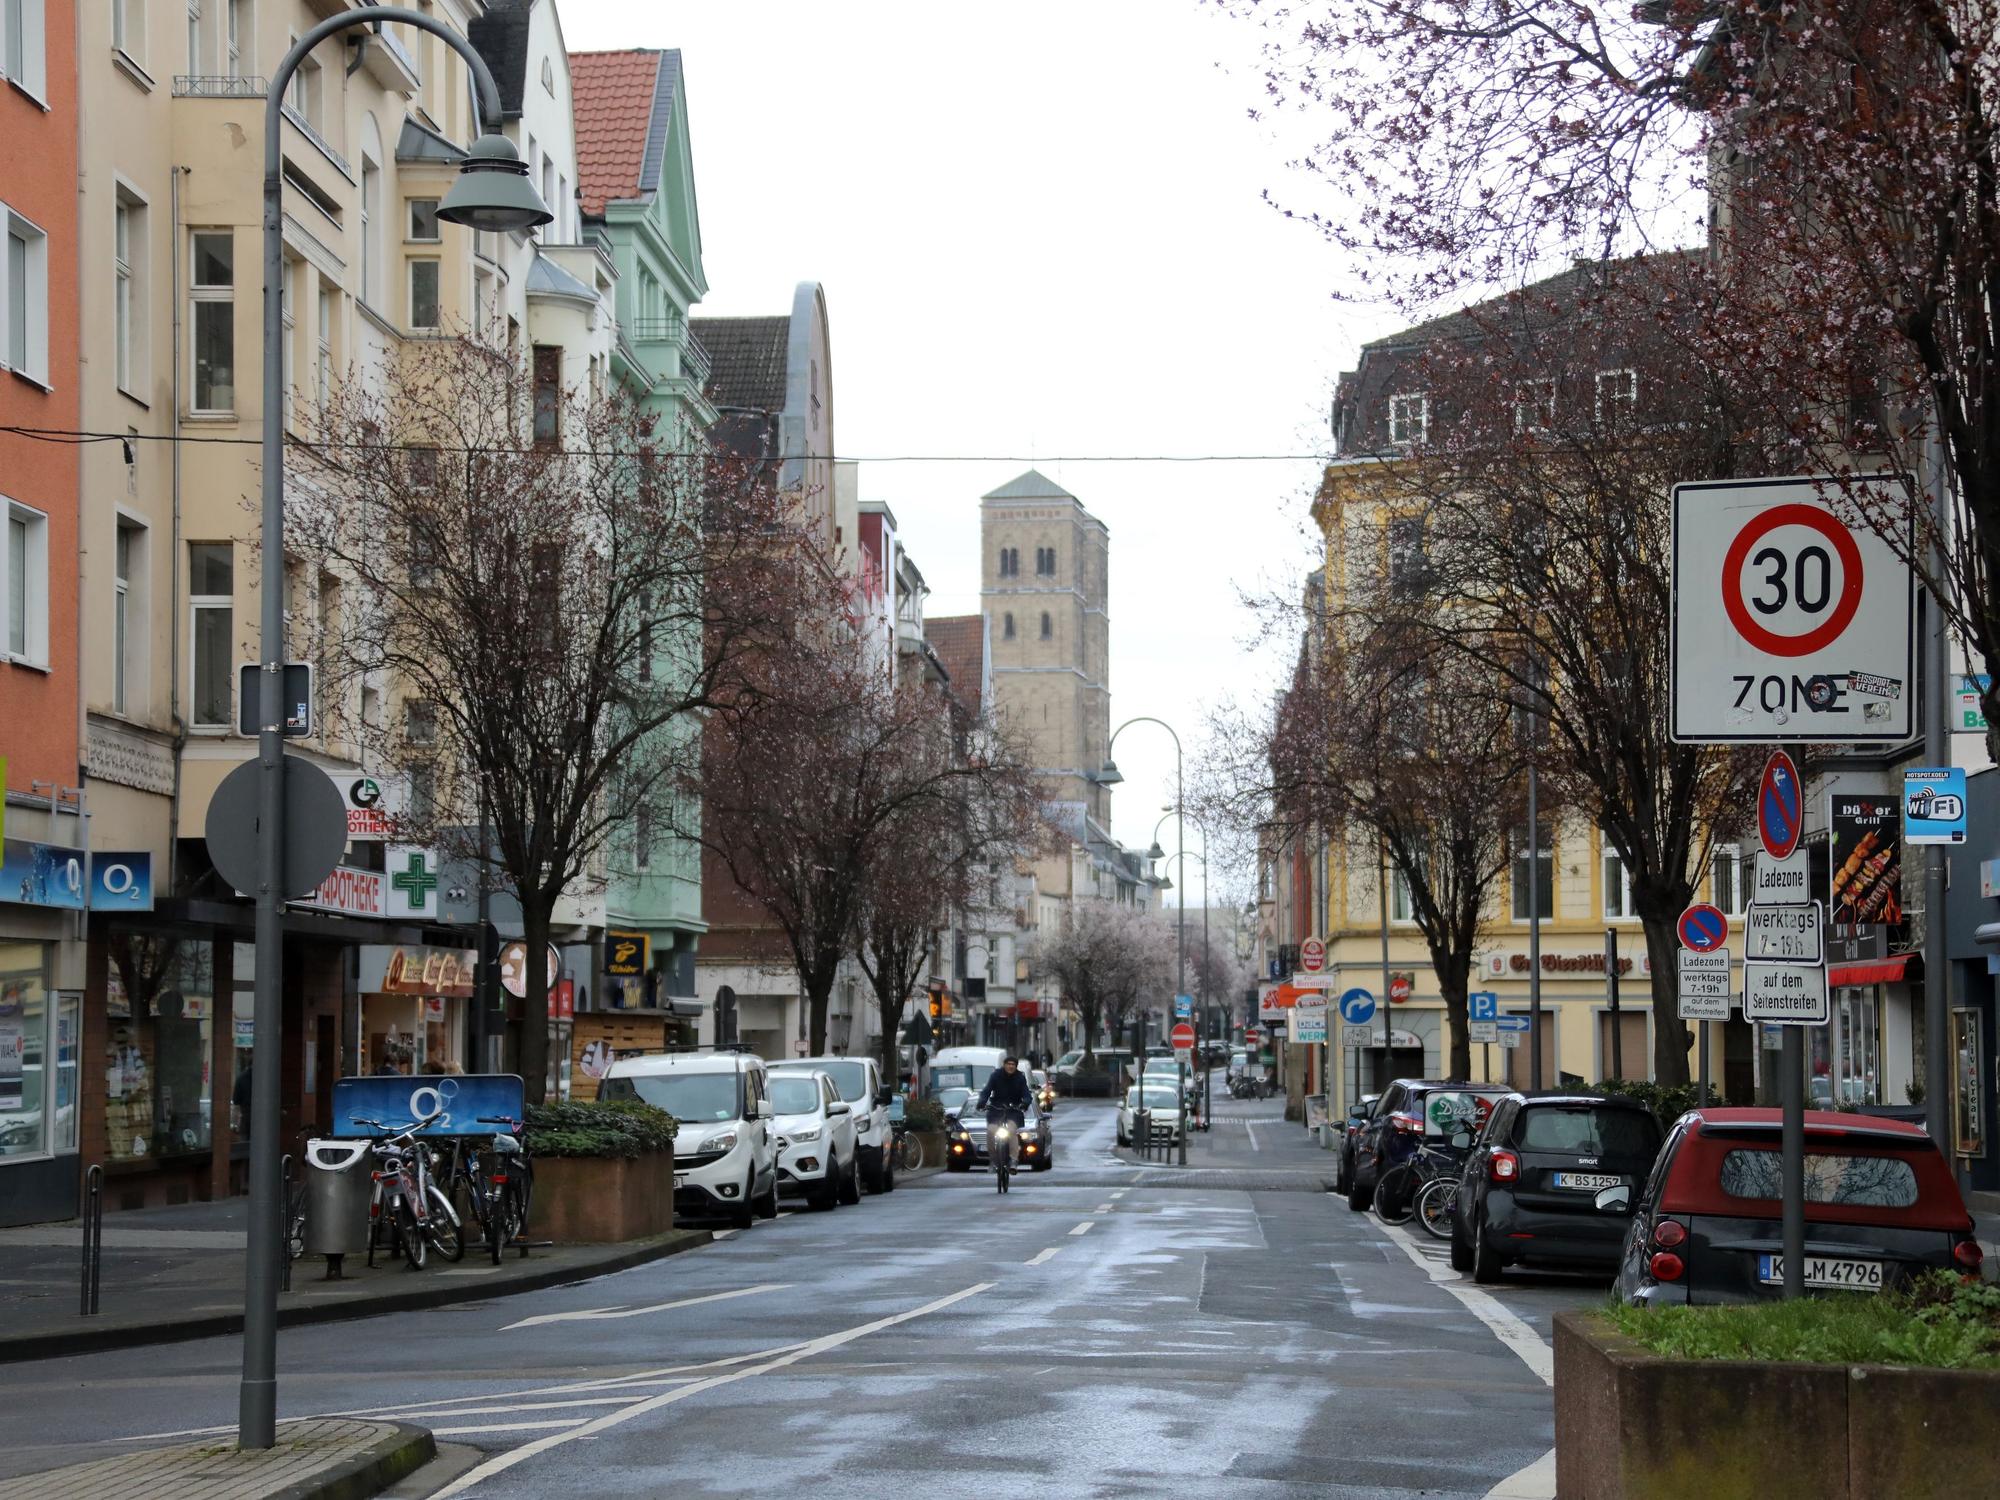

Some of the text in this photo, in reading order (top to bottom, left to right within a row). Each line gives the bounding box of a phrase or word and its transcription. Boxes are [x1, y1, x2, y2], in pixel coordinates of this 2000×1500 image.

[1752, 546, 1831, 615] 30
[1857, 673, 1890, 688] EISSPORT
[1732, 674, 1850, 714] ZONE
[1856, 682, 1889, 697] VEREIN
[1855, 816, 1880, 825] Grill
[1759, 867, 1804, 889] Ladezone
[1752, 908, 1815, 934] werktags
[1683, 956, 1725, 967] Ladezone
[1683, 973, 1728, 985] werktags
[1763, 971, 1803, 988] auf dem
[1704, 997, 1720, 1006] dem
[1752, 992, 1818, 1011] Seitenstreifen
[1437, 1100, 1488, 1116] Diana
[1560, 1174, 1568, 1186] K
[1575, 1175, 1590, 1187] BS
[1830, 1262, 1880, 1284] 4796
